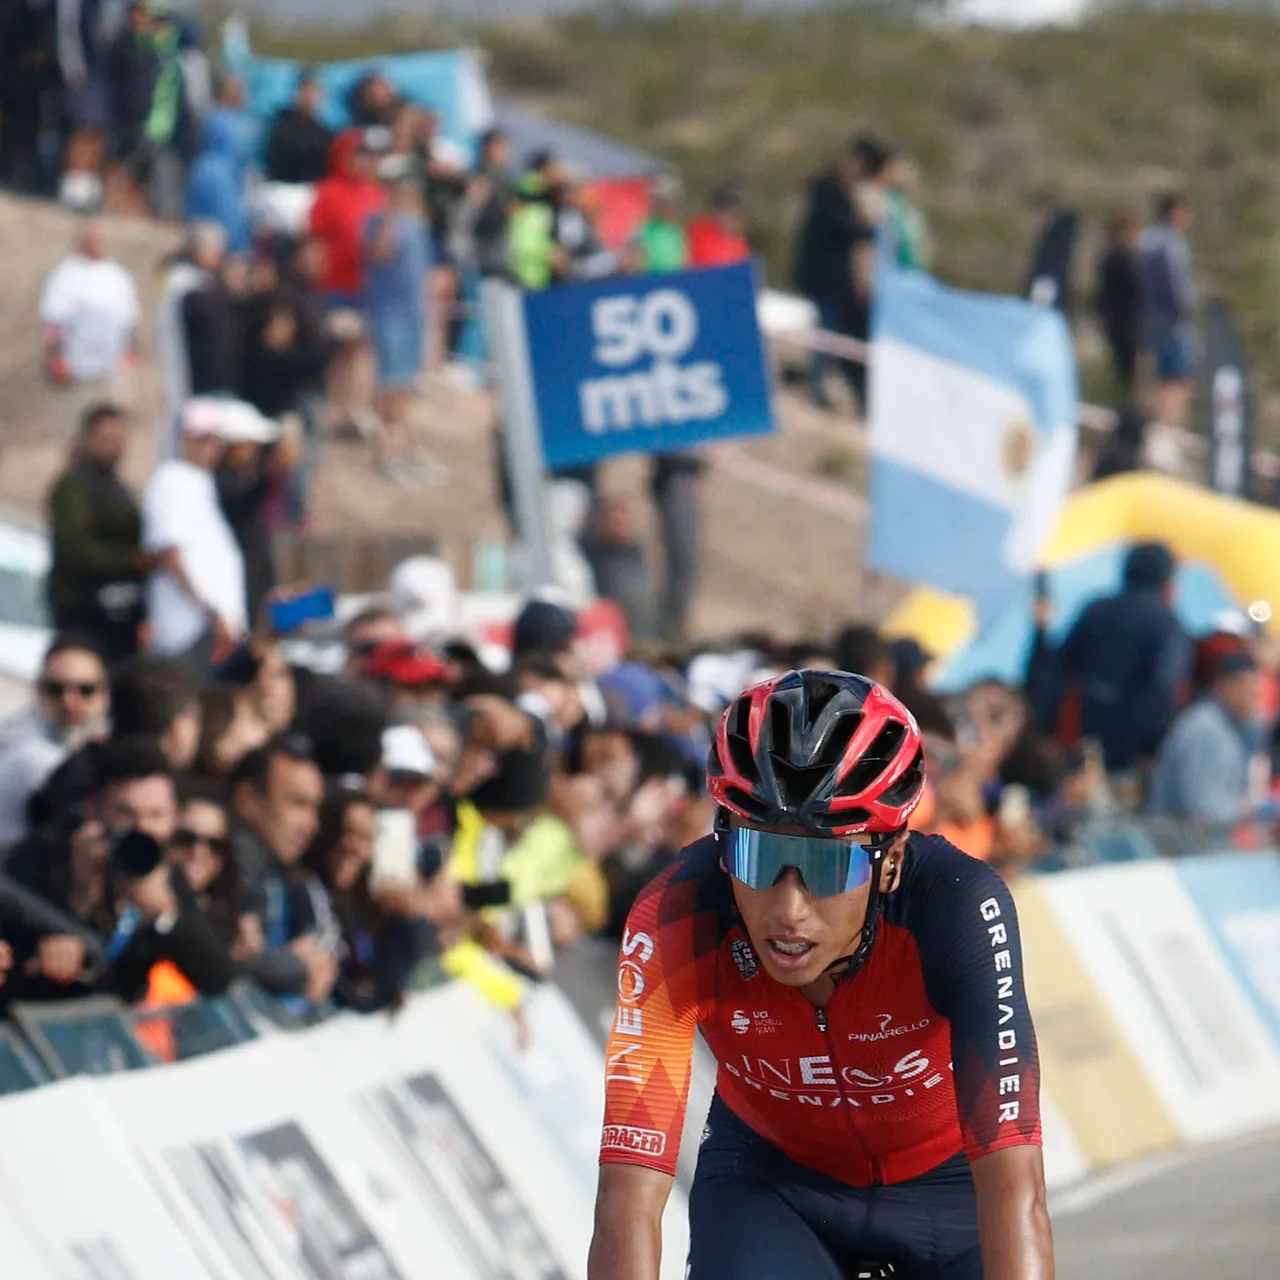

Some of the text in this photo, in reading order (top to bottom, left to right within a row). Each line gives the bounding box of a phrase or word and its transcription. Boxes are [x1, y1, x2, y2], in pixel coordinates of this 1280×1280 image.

[590, 288, 698, 368] 50
[578, 360, 729, 436] mts
[607, 927, 654, 1085] INEOS
[848, 1018, 930, 1042] PINARELLO
[979, 897, 1022, 1125] GRENADIER
[724, 1061, 953, 1107] GRENADIE
[741, 1049, 930, 1088] INEOS
